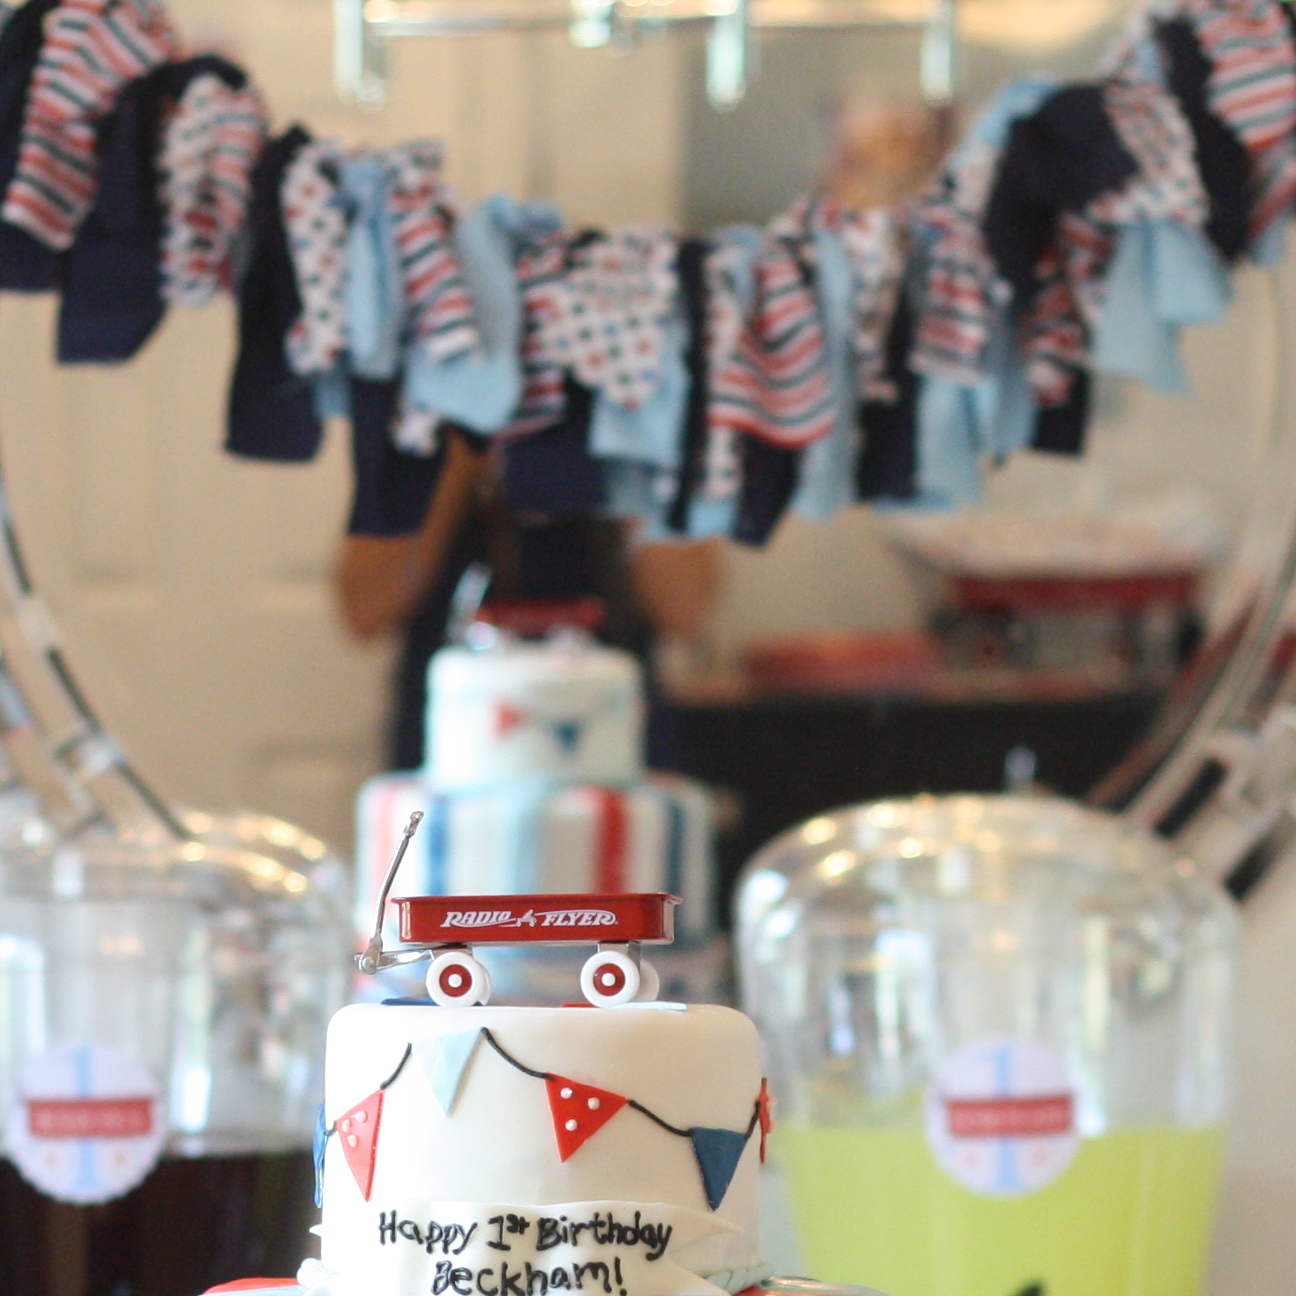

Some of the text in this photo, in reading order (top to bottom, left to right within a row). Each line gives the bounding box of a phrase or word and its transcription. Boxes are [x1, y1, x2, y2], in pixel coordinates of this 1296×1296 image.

[440, 909, 616, 928] RADIO FLYER
[378, 1209, 673, 1261] Happy 1st Birthday
